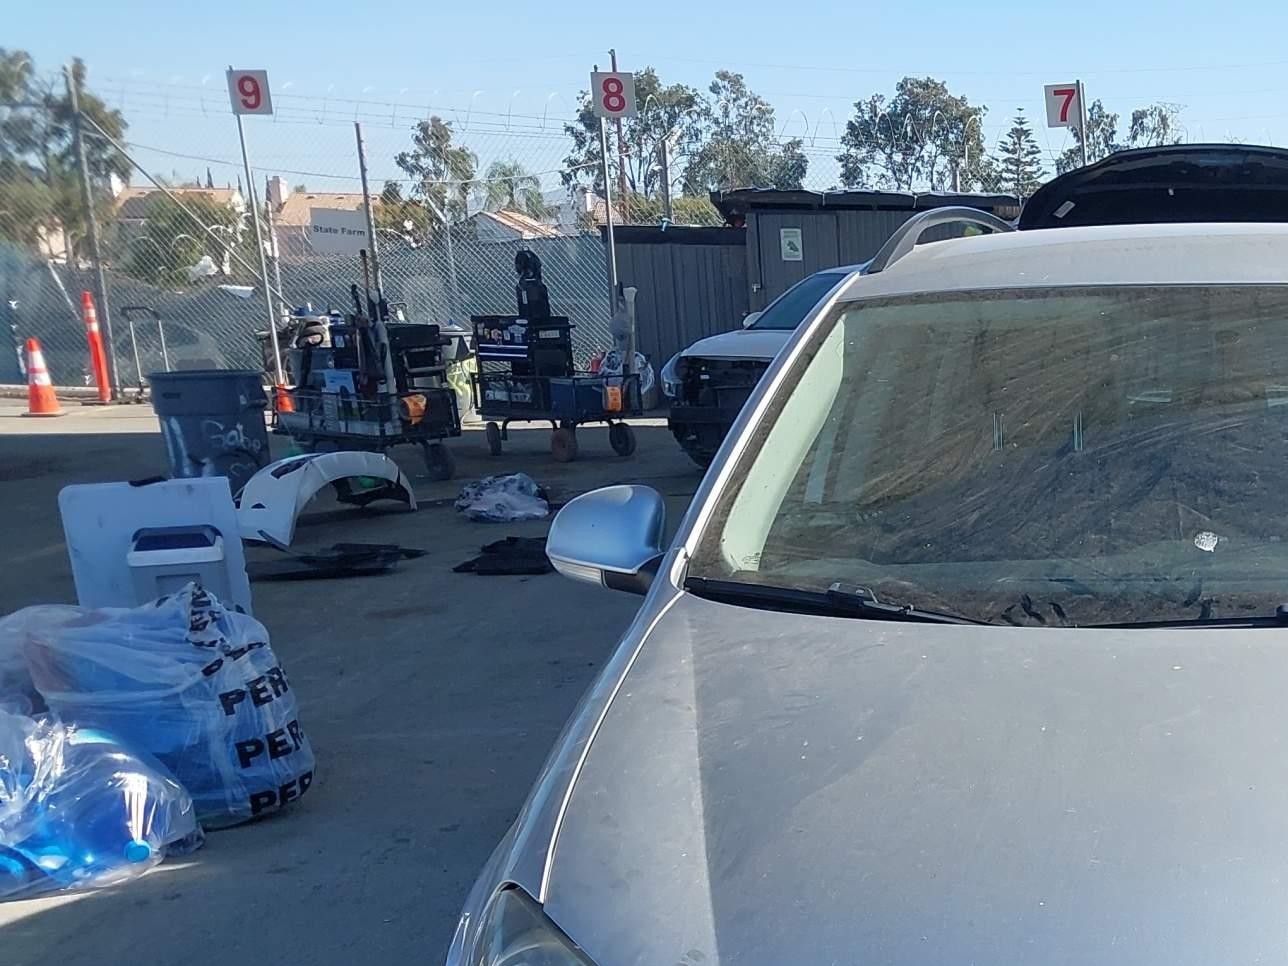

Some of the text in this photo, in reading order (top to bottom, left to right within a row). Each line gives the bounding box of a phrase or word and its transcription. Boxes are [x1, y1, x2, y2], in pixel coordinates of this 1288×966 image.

[238, 75, 261, 110] 9
[602, 77, 626, 112] 8
[1053, 88, 1076, 122] 7
[313, 224, 366, 237] State Farm
